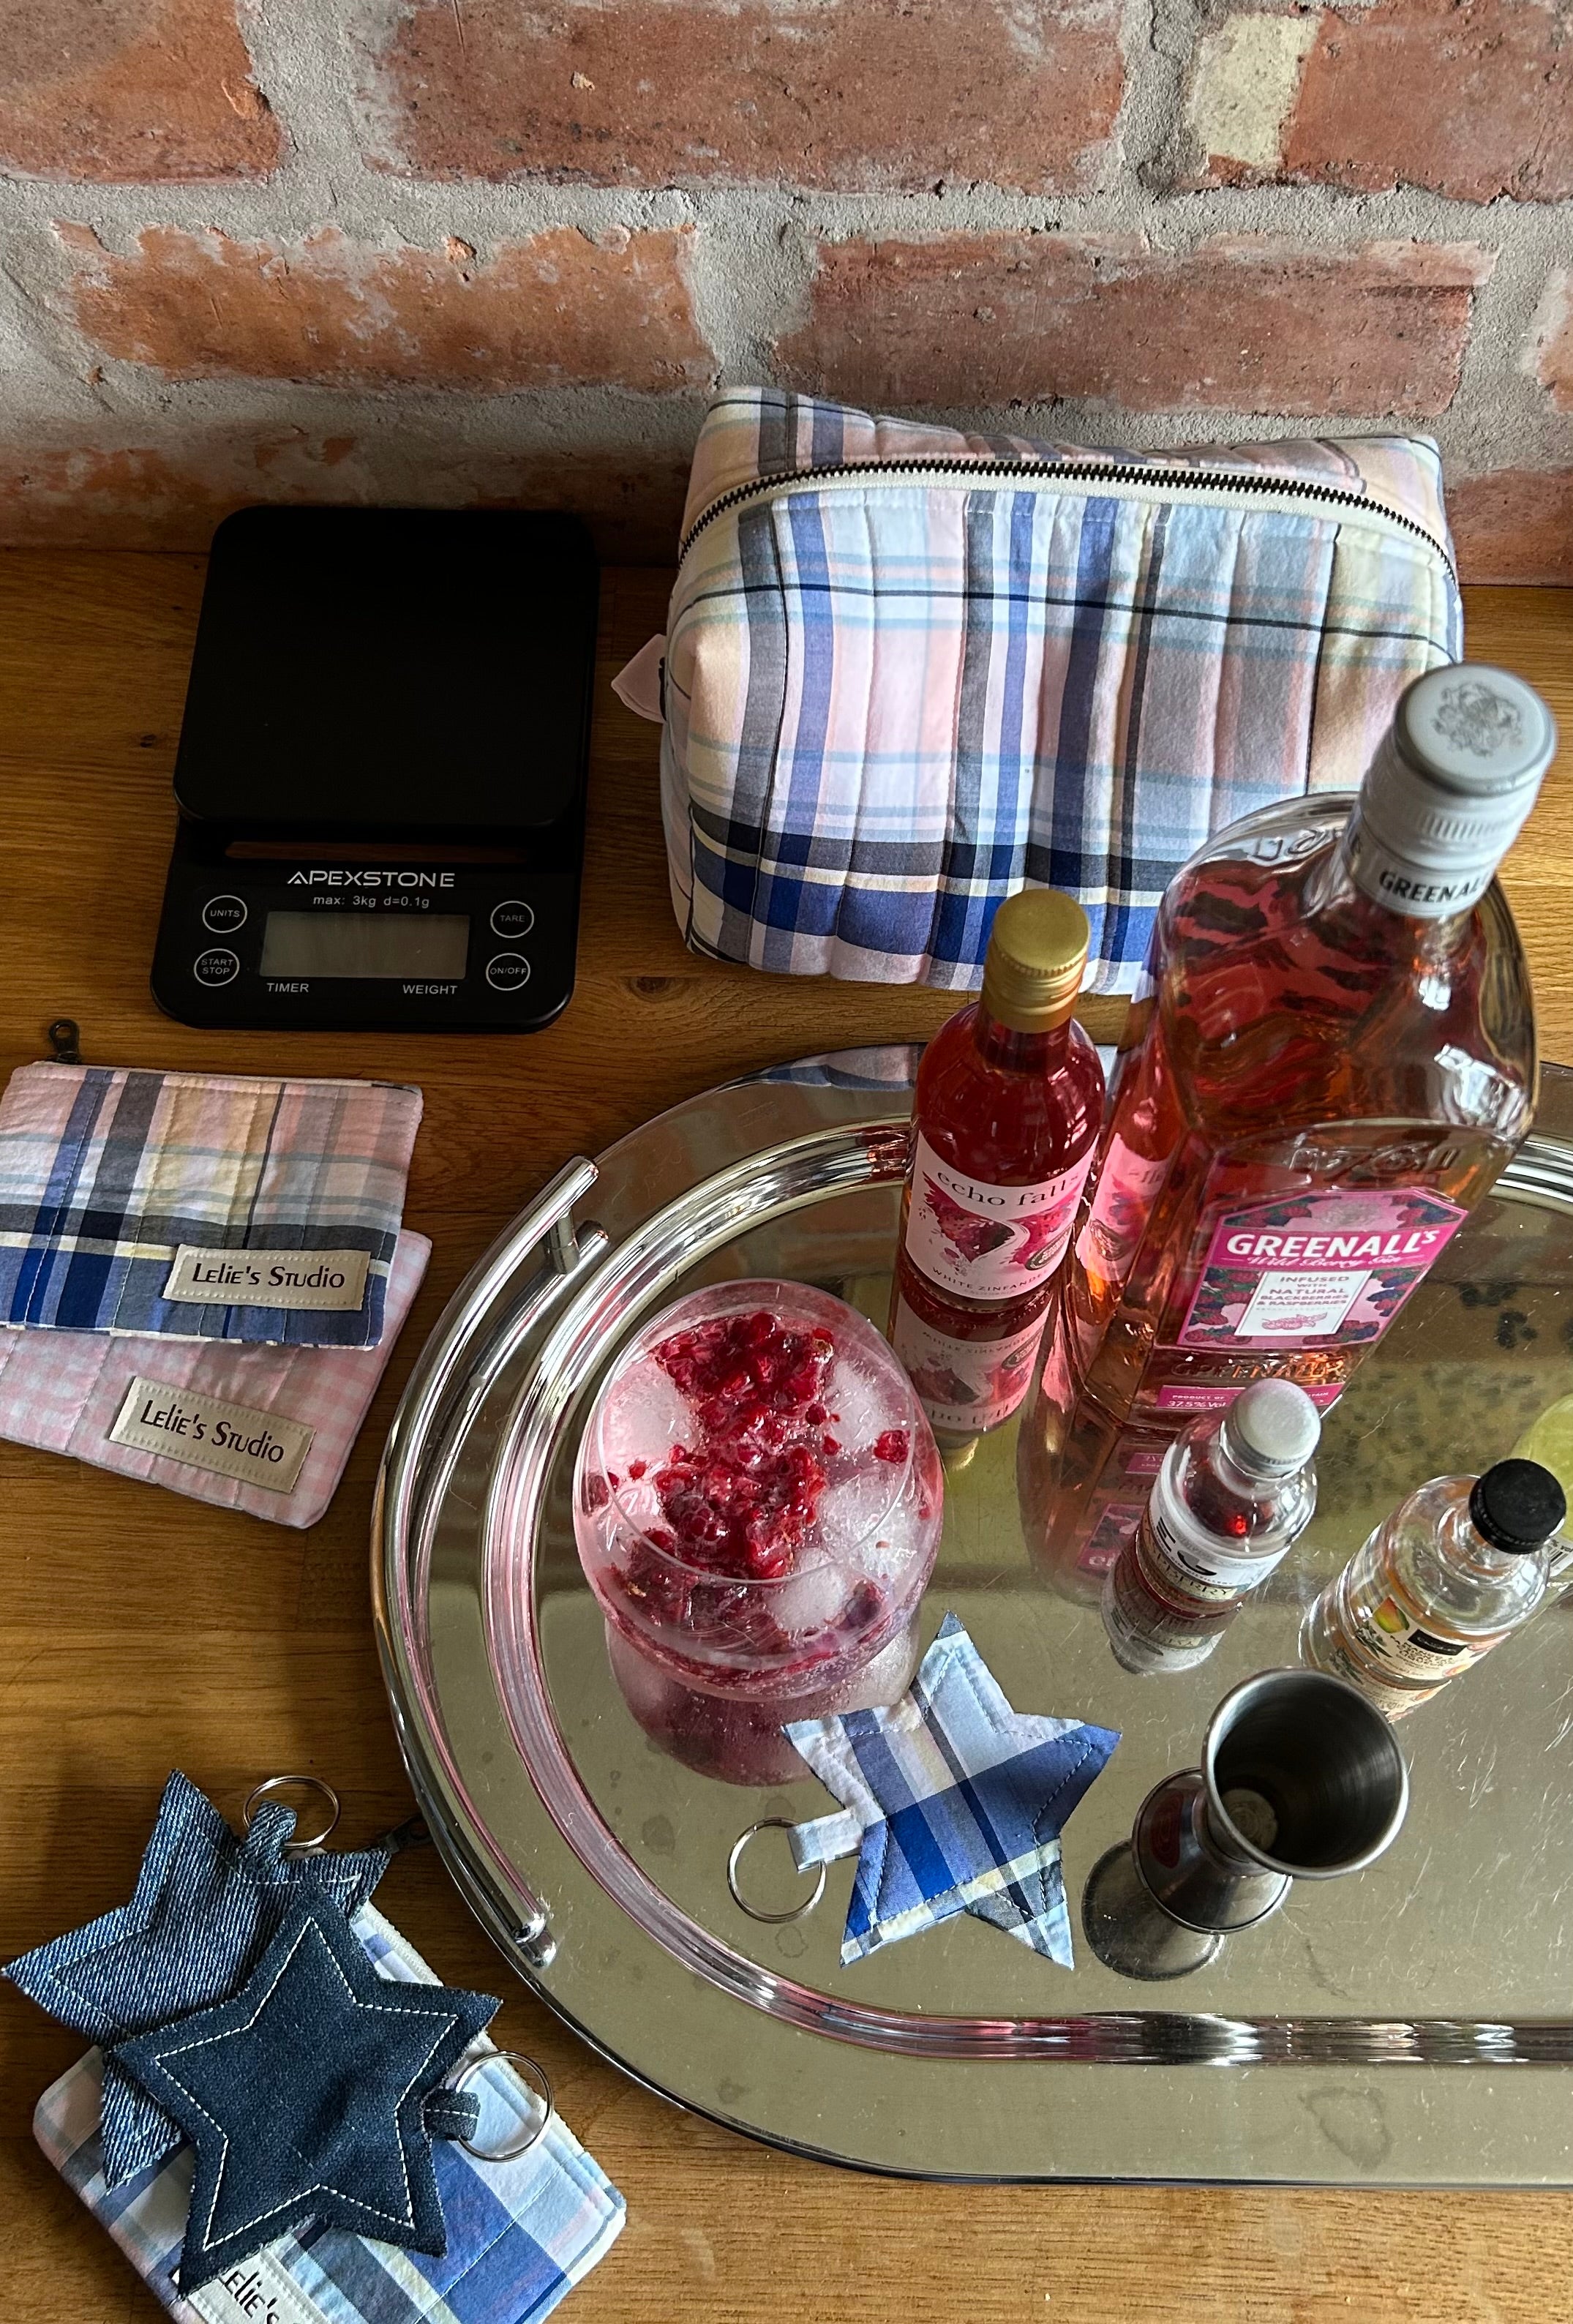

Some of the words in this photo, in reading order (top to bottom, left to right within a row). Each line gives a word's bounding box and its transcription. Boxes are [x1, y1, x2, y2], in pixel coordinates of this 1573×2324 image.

[287, 870, 455, 888] APEXSTONE
[313, 896, 345, 905] max:
[353, 895, 376, 907] 3kg
[383, 896, 429, 908] d=0.1g
[210, 910, 241, 918] UNITS
[266, 983, 309, 993] TIMER
[402, 984, 458, 994] WEIGHT
[937, 1172, 1006, 1207] echo
[1226, 1229, 1441, 1259] GREENALL'S
[268, 1266, 346, 1289] Studio
[932, 1267, 973, 1289] WHITE
[211, 1421, 285, 1463] Studio
[219, 2269, 280, 2324] elie's
